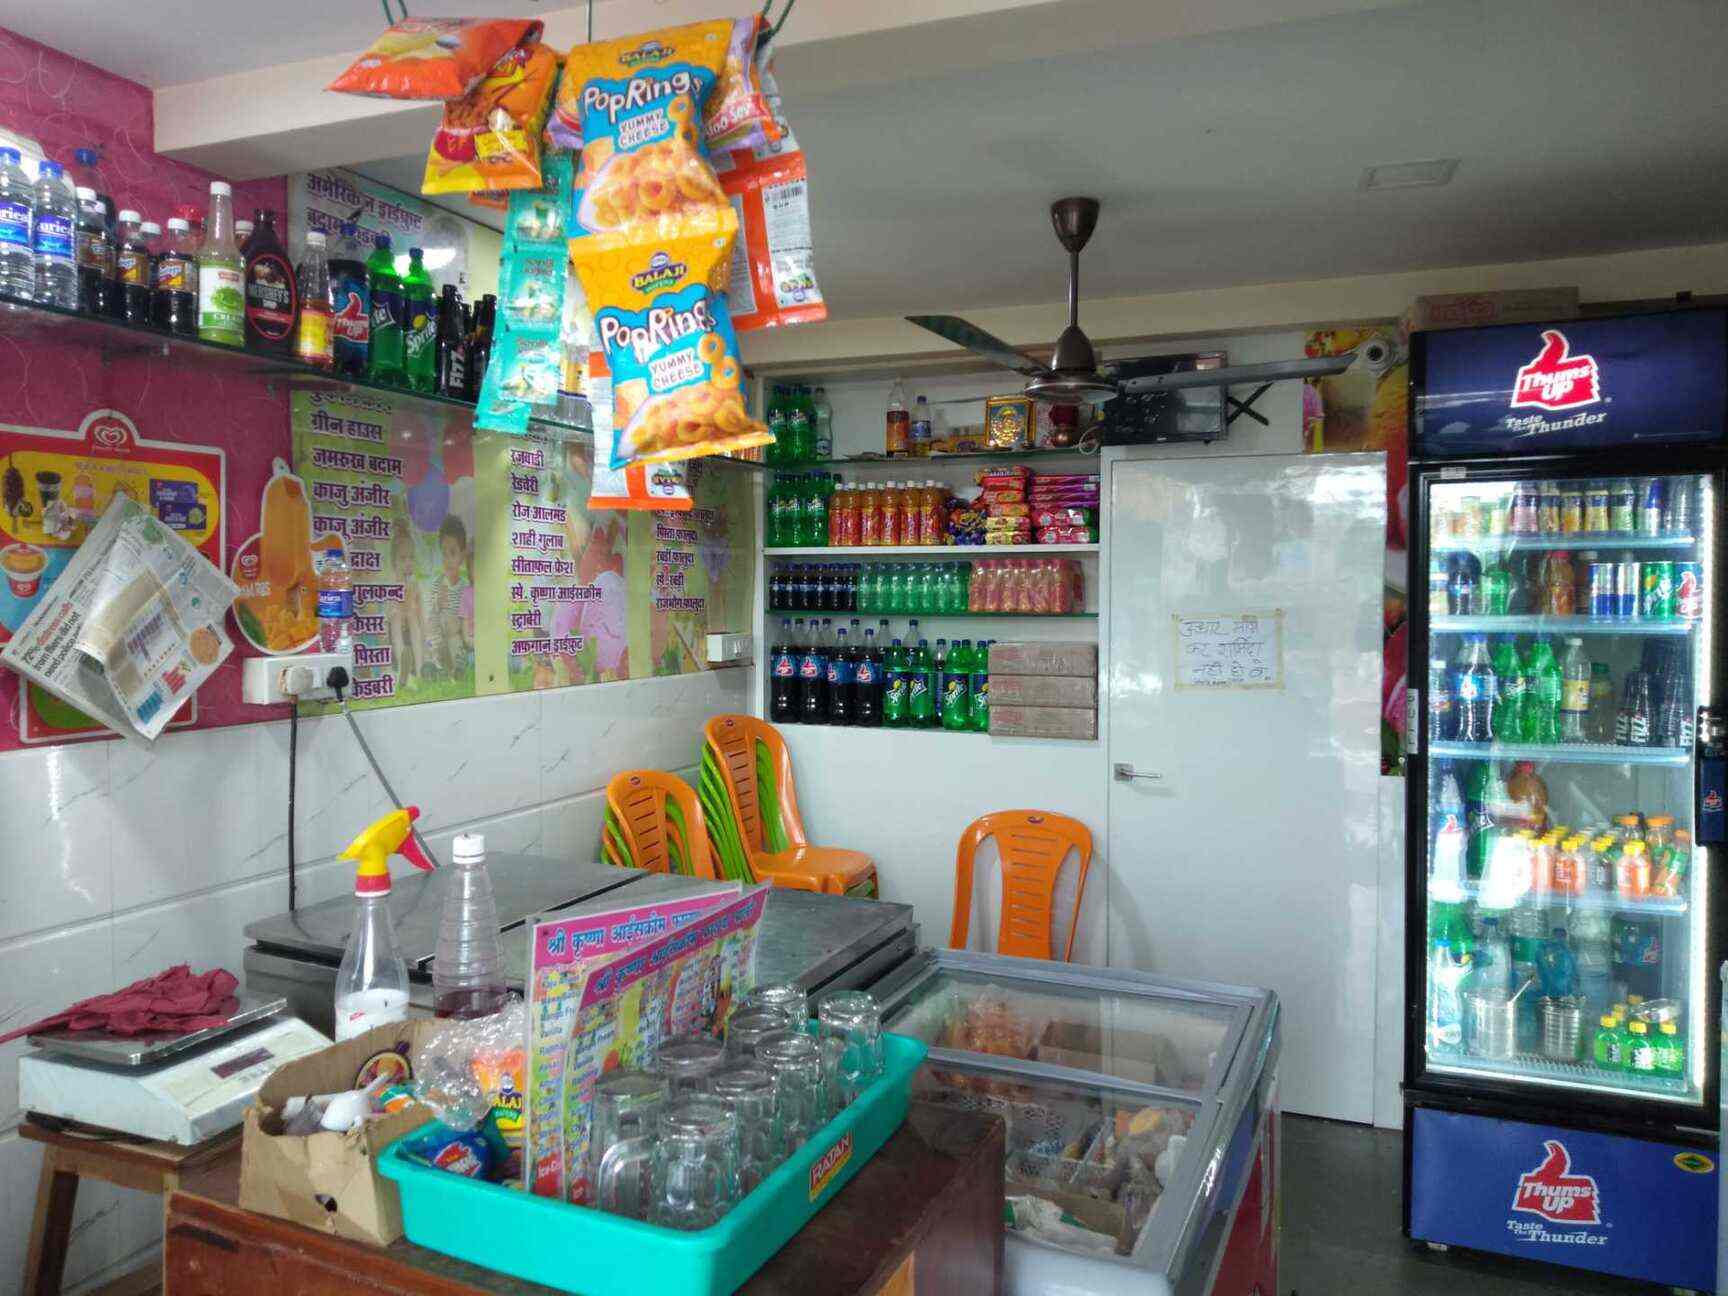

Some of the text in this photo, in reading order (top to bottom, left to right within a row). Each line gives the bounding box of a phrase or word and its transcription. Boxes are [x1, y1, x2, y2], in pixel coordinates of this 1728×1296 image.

[1520, 364, 1592, 392] Thums
[1527, 412, 1608, 434] Thunder
[547, 928, 567, 956] श्री
[571, 928, 605, 960] कृष्णा
[1522, 1181, 1592, 1199] Thums
[1506, 1220, 1544, 1232] Taste
[1527, 1229, 1609, 1245] Thunder
